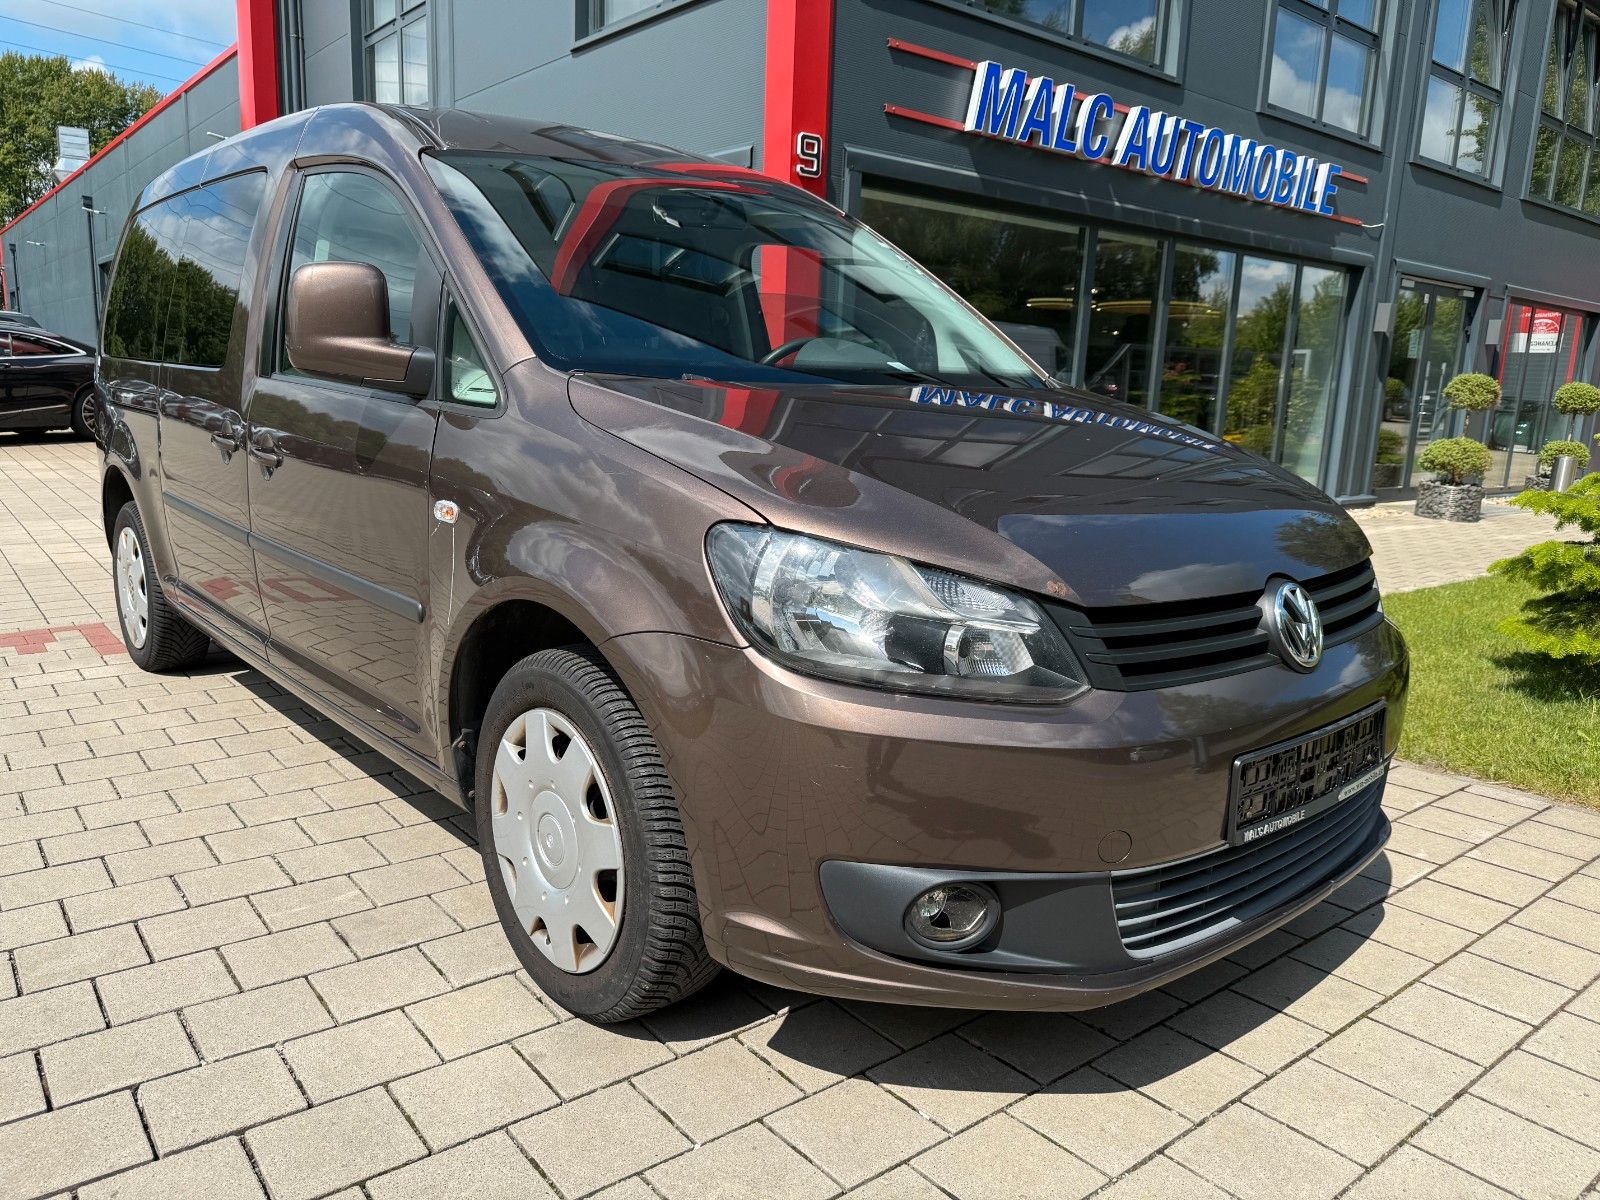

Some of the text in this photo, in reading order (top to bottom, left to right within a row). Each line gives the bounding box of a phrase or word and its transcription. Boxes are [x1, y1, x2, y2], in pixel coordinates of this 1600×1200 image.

[796, 131, 823, 178] 9
[965, 60, 1343, 216] MALC AUTOMOBILE
[1264, 809, 1306, 835] AUTOMOBILE
